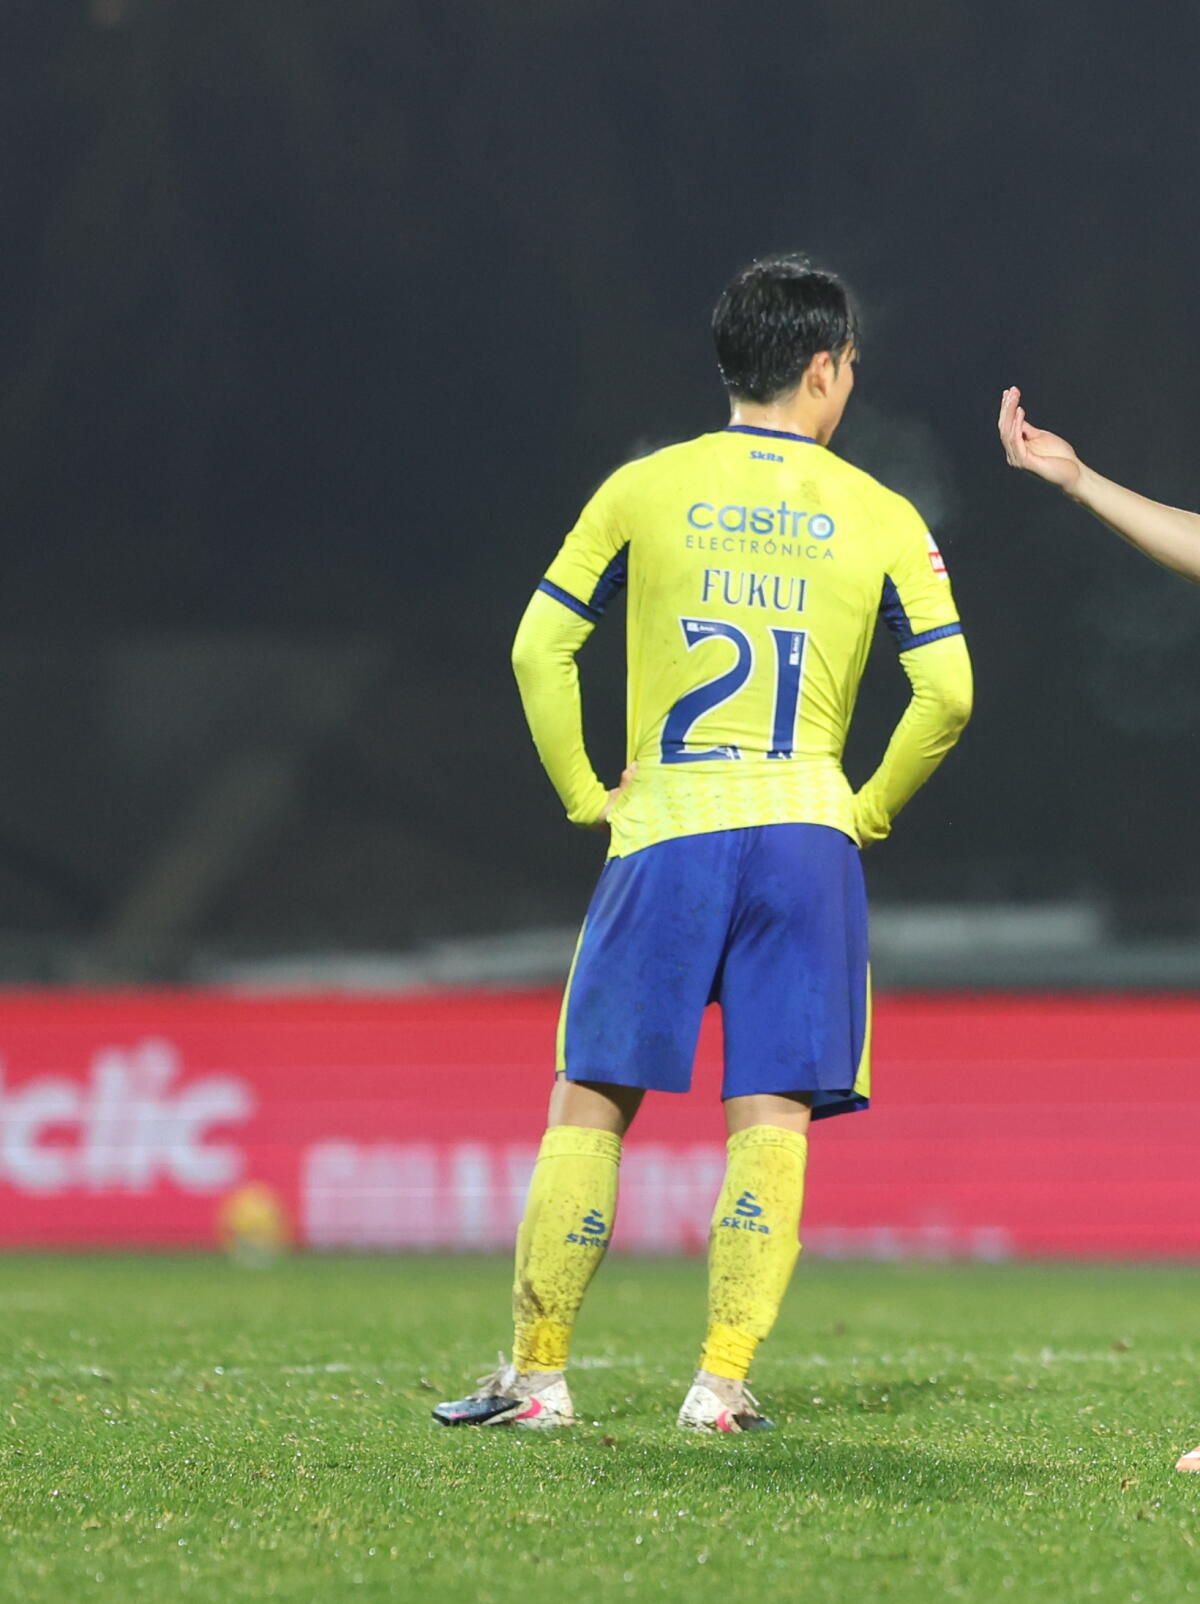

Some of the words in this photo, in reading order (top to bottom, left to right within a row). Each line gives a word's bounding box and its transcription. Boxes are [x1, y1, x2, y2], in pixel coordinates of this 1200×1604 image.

[687, 500, 836, 541] castro
[685, 535, 834, 560] ELECTRÓNICA
[701, 568, 807, 613] FUKUI
[660, 616, 808, 764] 21
[0, 1036, 258, 1196] clic
